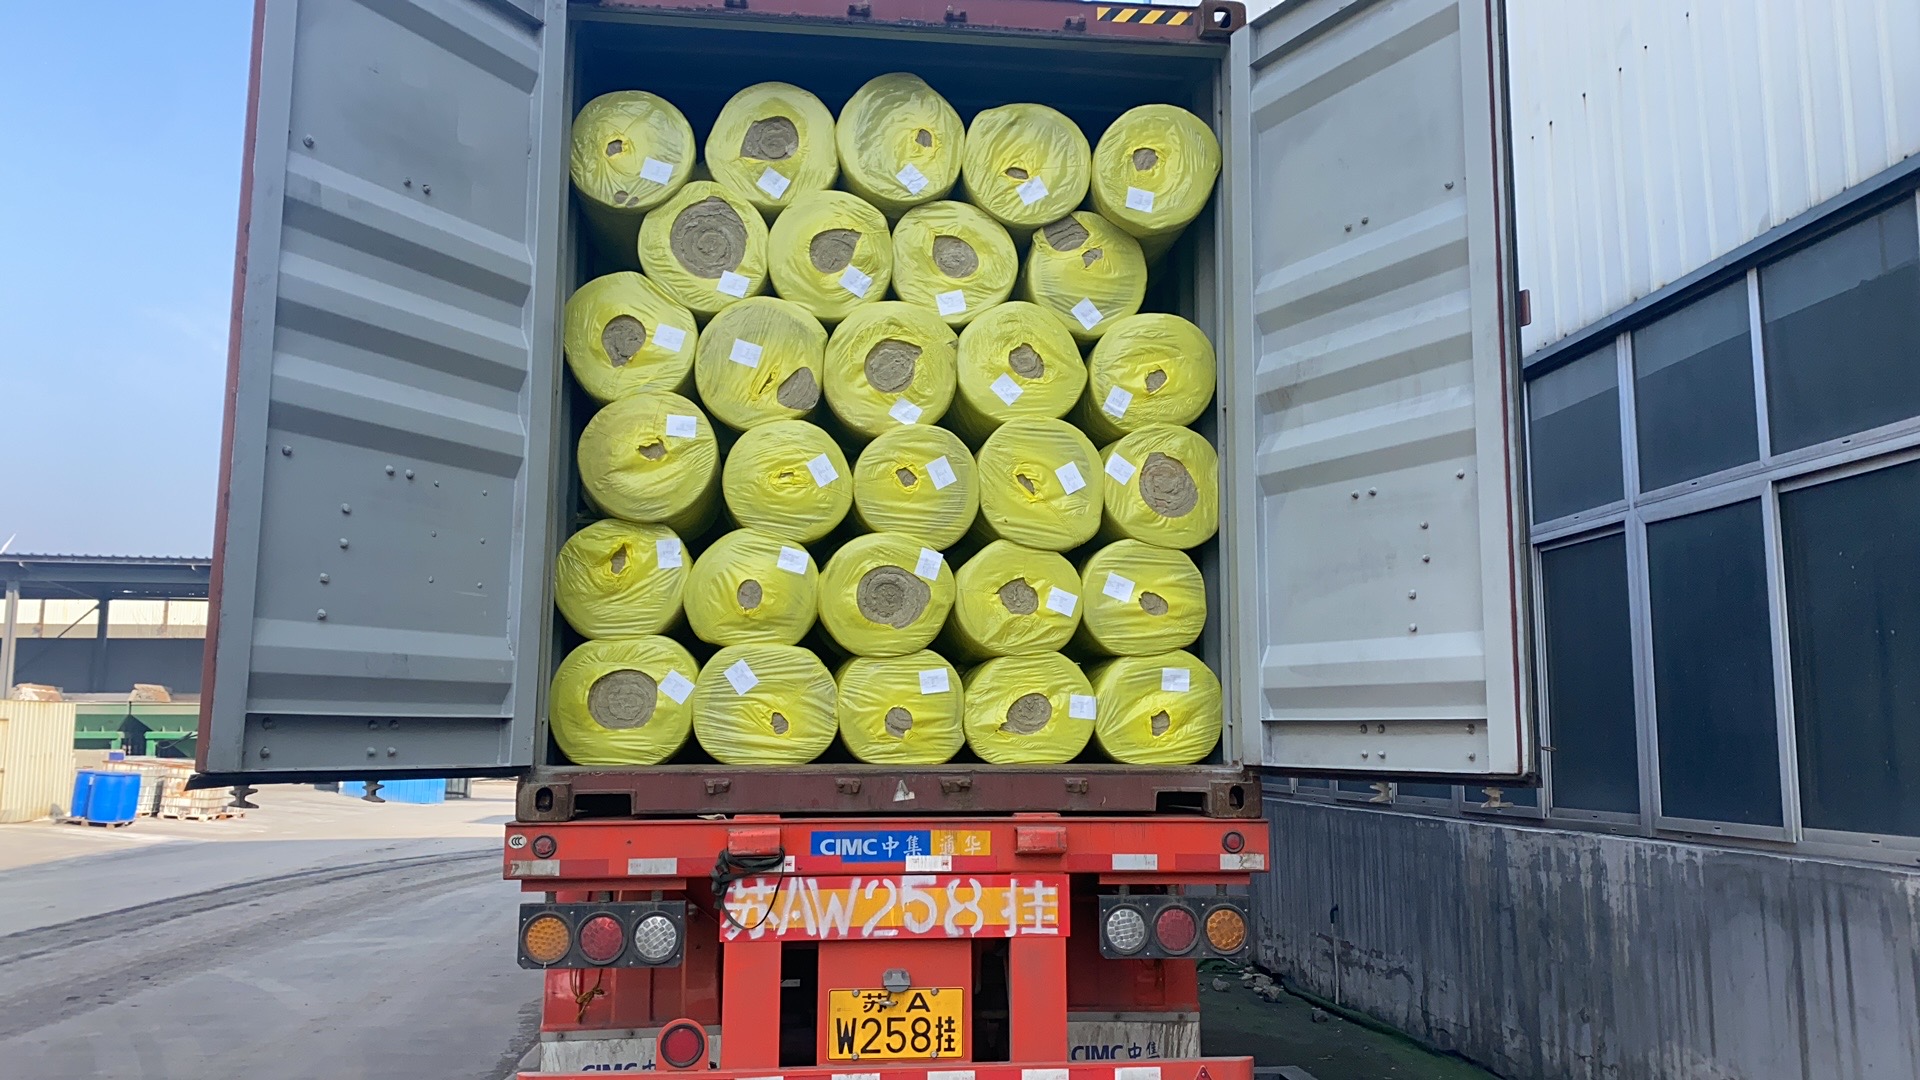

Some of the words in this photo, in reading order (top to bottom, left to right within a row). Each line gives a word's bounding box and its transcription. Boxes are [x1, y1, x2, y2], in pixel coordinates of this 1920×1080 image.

[819, 838, 878, 856] CIMC
[881, 835, 923, 858] 中集
[940, 835, 982, 856] 通华
[836, 1016, 956, 1055] W258挂
[1071, 1044, 1123, 1060] CIMC
